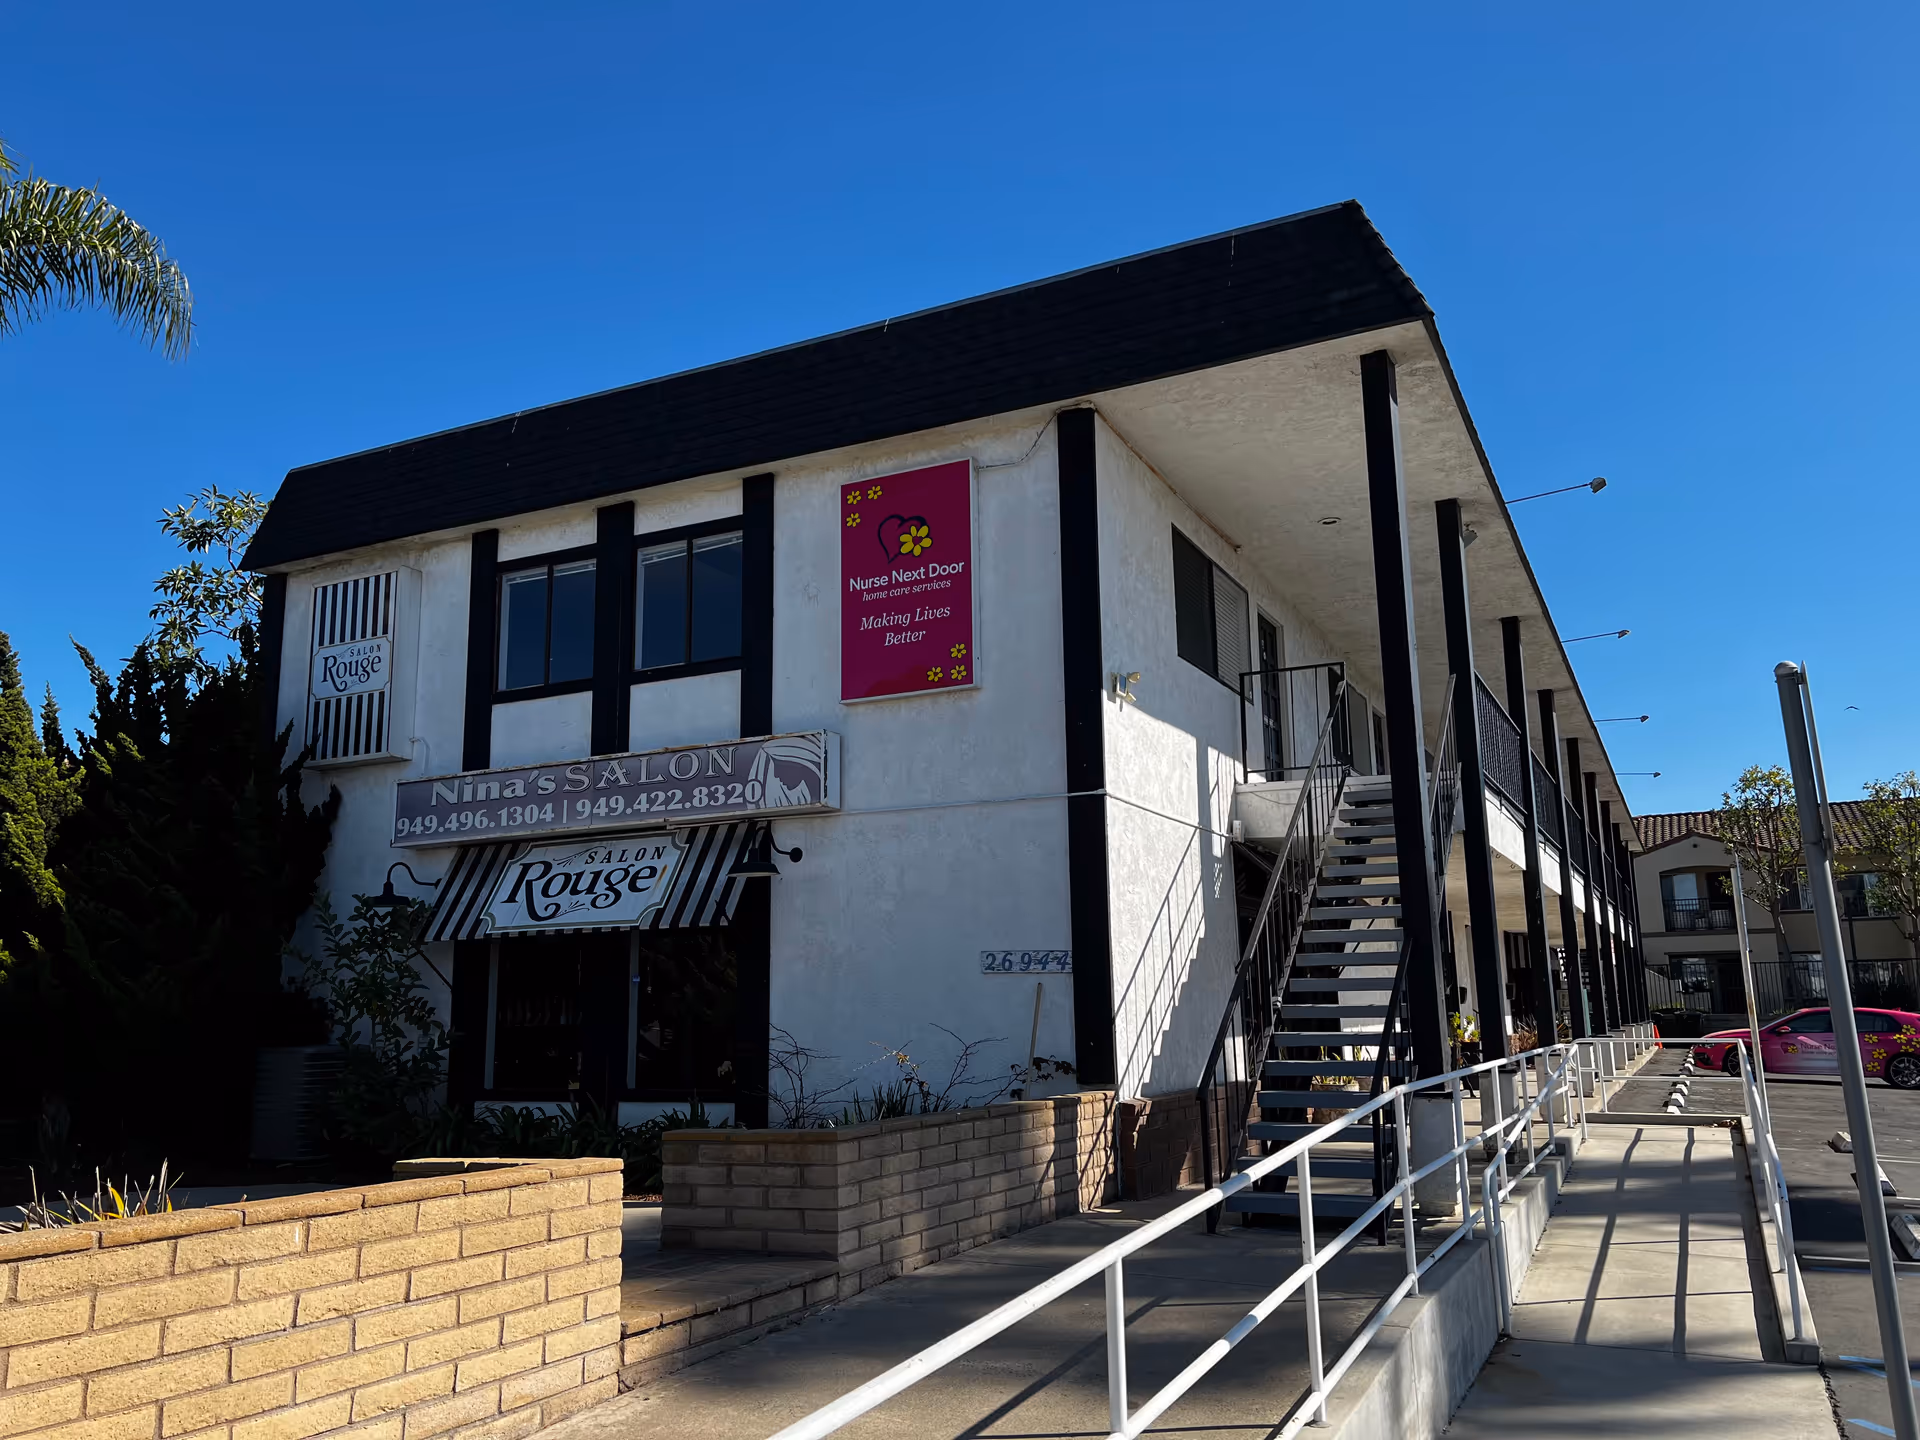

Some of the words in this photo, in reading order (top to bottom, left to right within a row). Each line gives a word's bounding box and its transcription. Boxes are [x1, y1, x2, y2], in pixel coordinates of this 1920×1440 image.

[849, 575, 889, 592] Nurse
[892, 566, 926, 584] Next
[928, 561, 965, 578] Door
[862, 590, 888, 602] home
[889, 586, 911, 597] care
[912, 579, 952, 593] services
[859, 611, 911, 631] Making
[914, 606, 951, 622] Lives
[349, 643, 383, 658] SALON
[884, 630, 927, 647] Better
[321, 655, 382, 692] Rouge
[430, 769, 558, 807] Nina's
[562, 746, 738, 793] SALON
[397, 802, 555, 837] 949.496.1304
[575, 780, 762, 820] 949.422.8320
[584, 845, 668, 865] SALON
[500, 860, 658, 922] Rouge
[984, 952, 1072, 972] 26944
